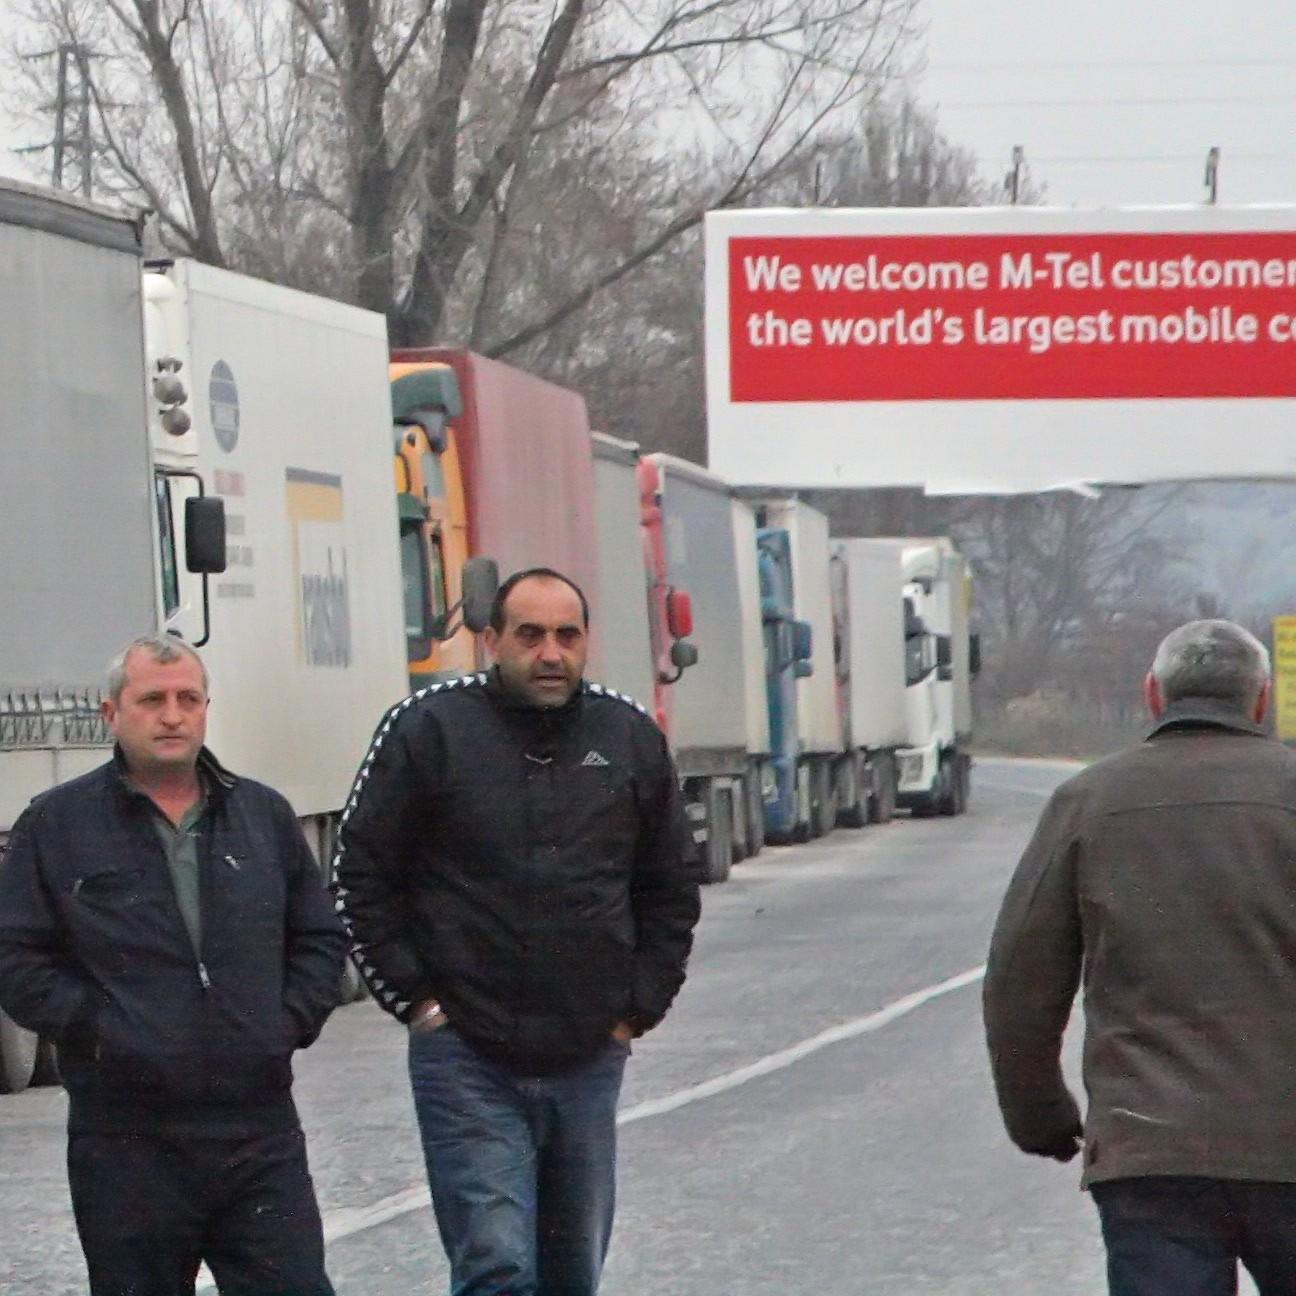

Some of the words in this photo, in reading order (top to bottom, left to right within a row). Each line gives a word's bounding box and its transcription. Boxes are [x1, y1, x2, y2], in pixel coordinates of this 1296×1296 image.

[743, 254, 802, 292] We
[811, 254, 990, 292] welcome
[999, 251, 1105, 290] M-Tel
[746, 309, 813, 347] the
[821, 307, 965, 346] world's
[975, 307, 1116, 355] largest
[1119, 304, 1258, 345] mobile
[1268, 313, 1296, 344] c
